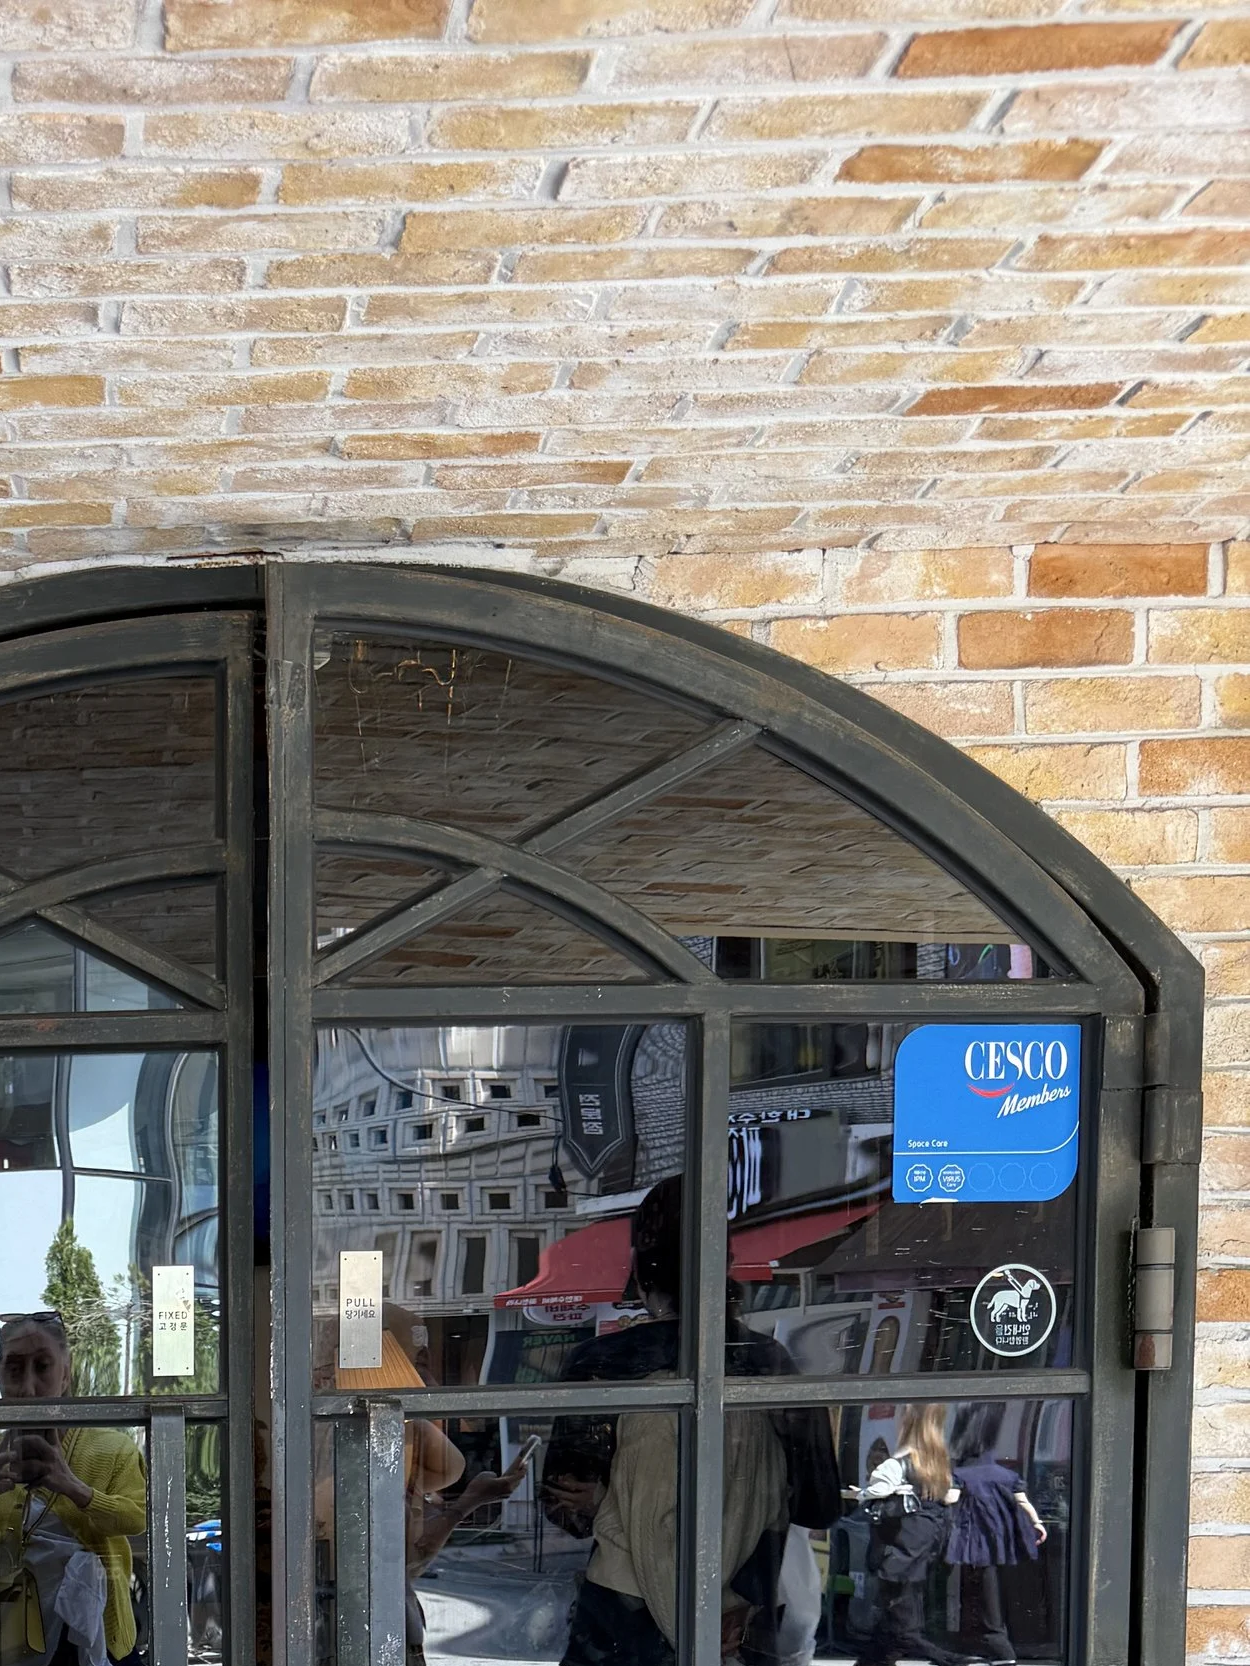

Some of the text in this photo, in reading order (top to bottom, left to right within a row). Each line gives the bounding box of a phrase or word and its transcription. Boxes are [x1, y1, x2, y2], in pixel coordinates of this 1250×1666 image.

[964, 1040, 1068, 1081] CESCO
[997, 1083, 1071, 1118] Members
[908, 1139, 948, 1149] Space Care
[346, 1298, 375, 1307] PULL
[158, 1311, 188, 1320] FIXED
[345, 1309, 376, 1319] 당기세요
